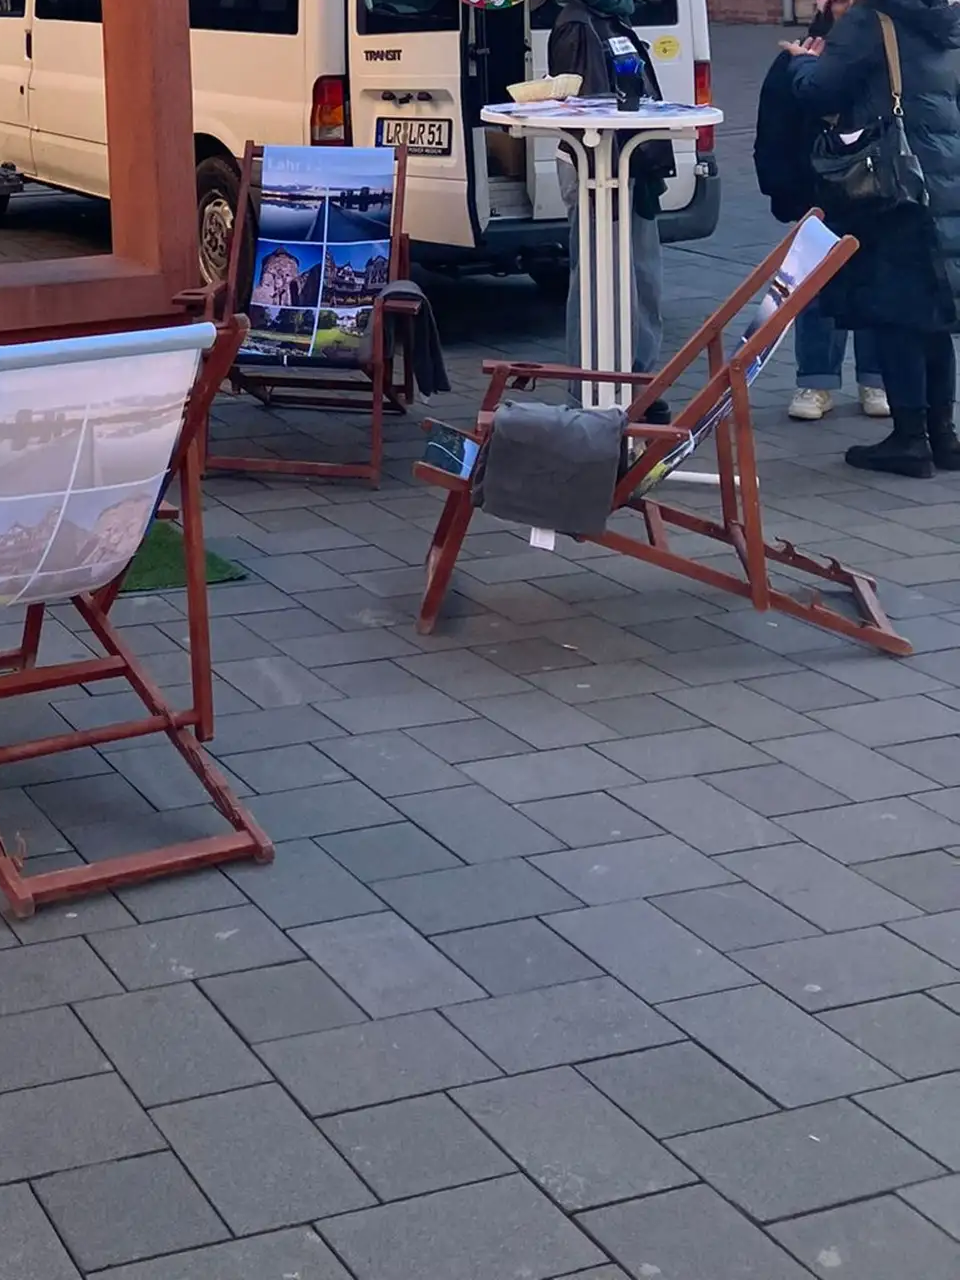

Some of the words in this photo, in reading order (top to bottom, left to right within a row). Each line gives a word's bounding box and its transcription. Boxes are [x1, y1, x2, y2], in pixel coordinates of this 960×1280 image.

[363, 49, 402, 61] TRANSIT
[386, 122, 401, 144] LR
[408, 123, 426, 145] LR
[427, 123, 443, 146] 51
